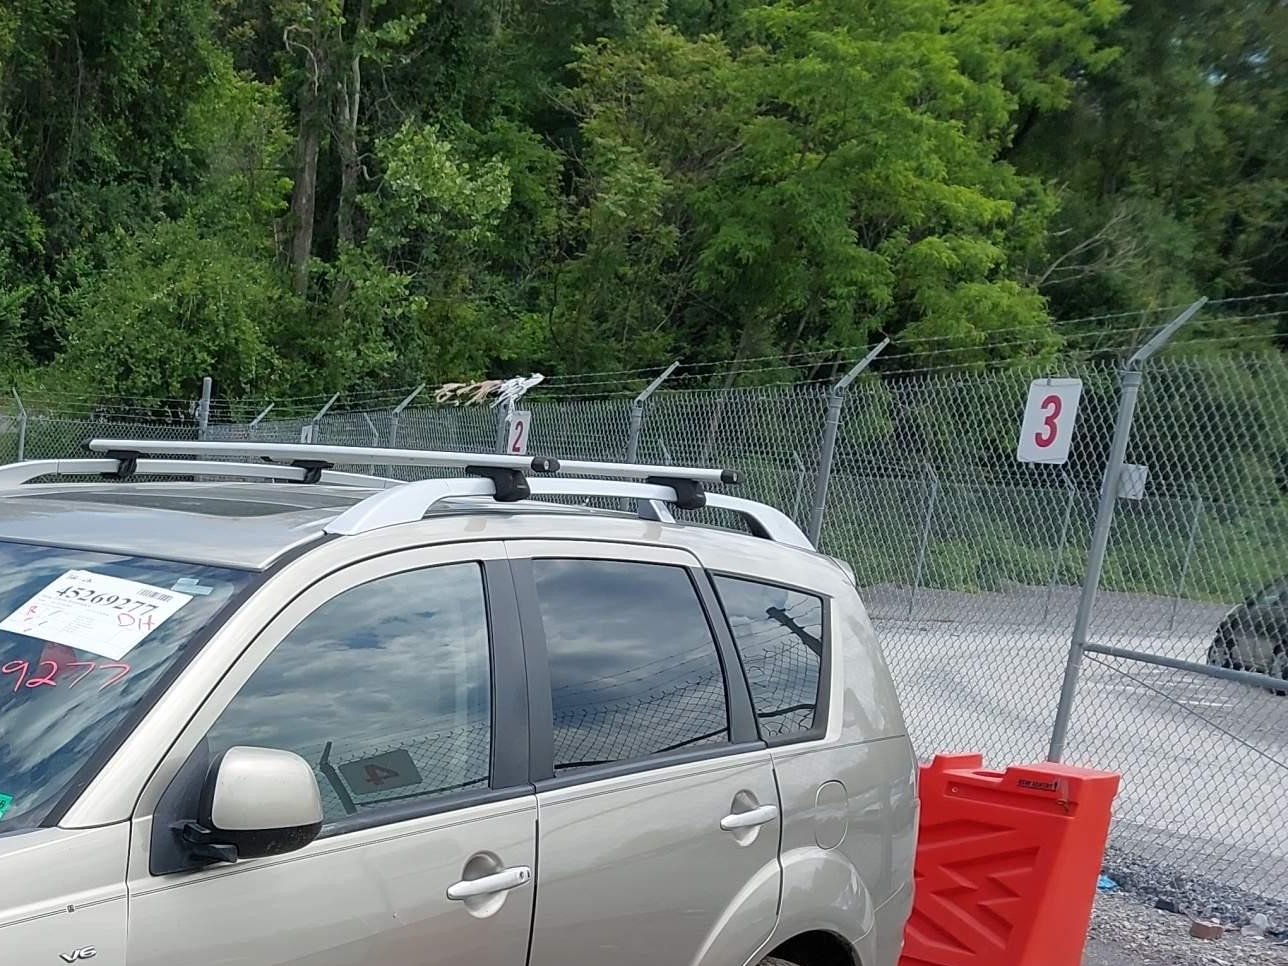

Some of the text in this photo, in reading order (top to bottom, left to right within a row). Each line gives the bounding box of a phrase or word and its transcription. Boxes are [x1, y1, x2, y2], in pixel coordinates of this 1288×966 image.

[512, 420, 524, 453] 2
[1034, 394, 1063, 449] 3
[56, 585, 159, 616] 45269277
[1, 660, 131, 693] 9277
[58, 944, 97, 964] V6
